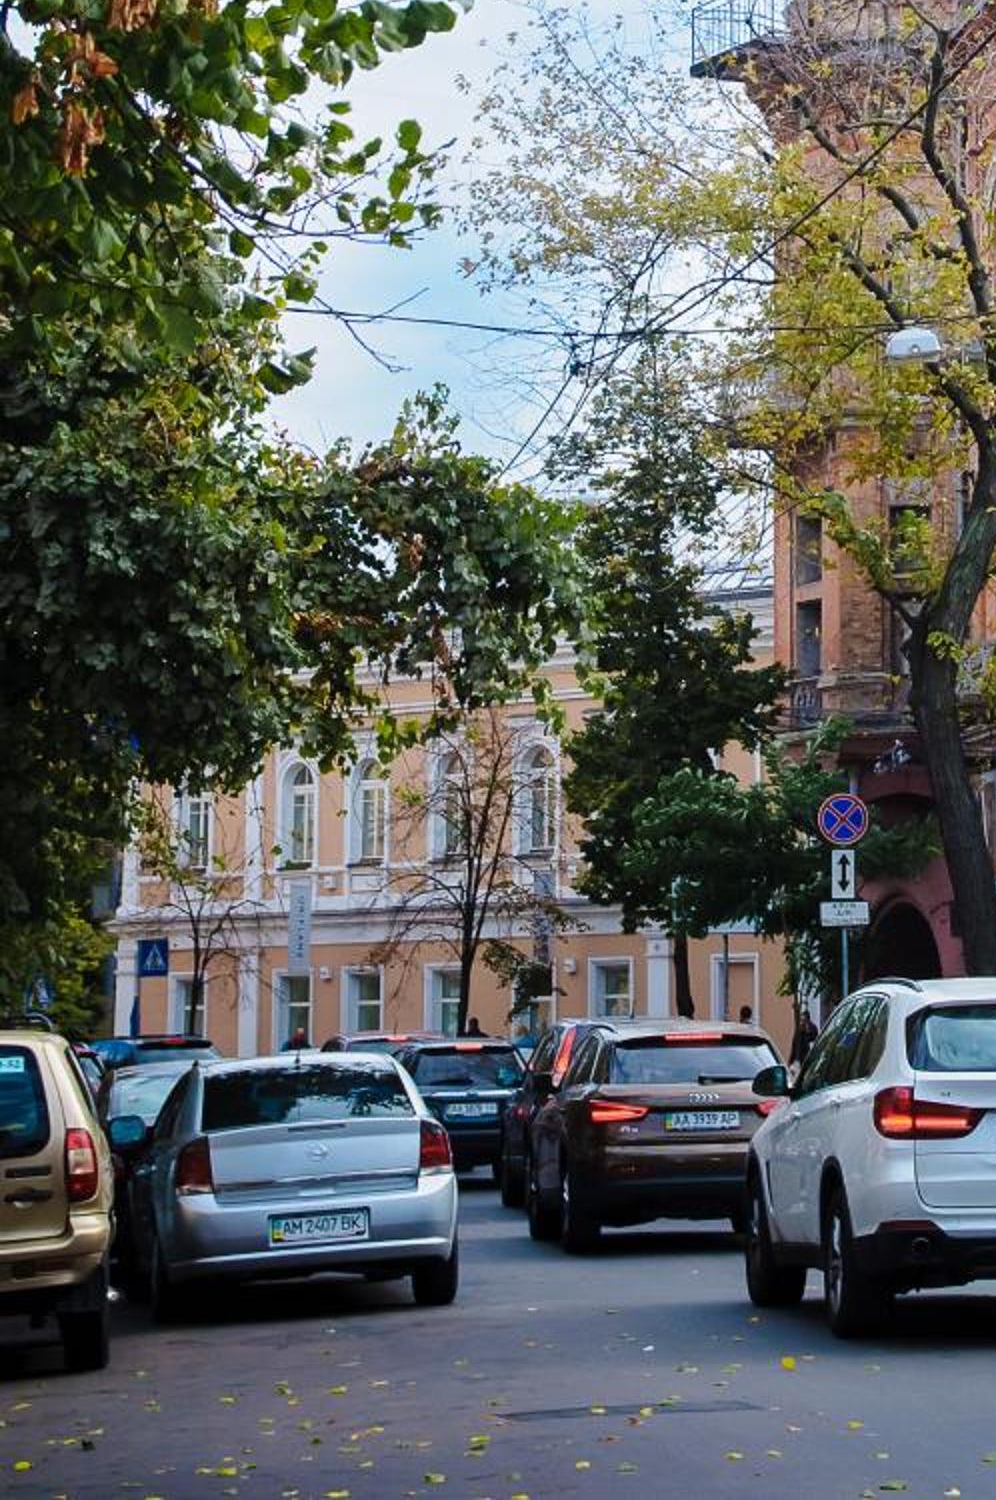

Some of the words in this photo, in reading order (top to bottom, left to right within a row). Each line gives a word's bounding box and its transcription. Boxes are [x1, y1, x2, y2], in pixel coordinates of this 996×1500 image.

[283, 1221, 304, 1235] AM
[306, 1217, 338, 1233] 2407
[341, 1213, 362, 1231] BK
